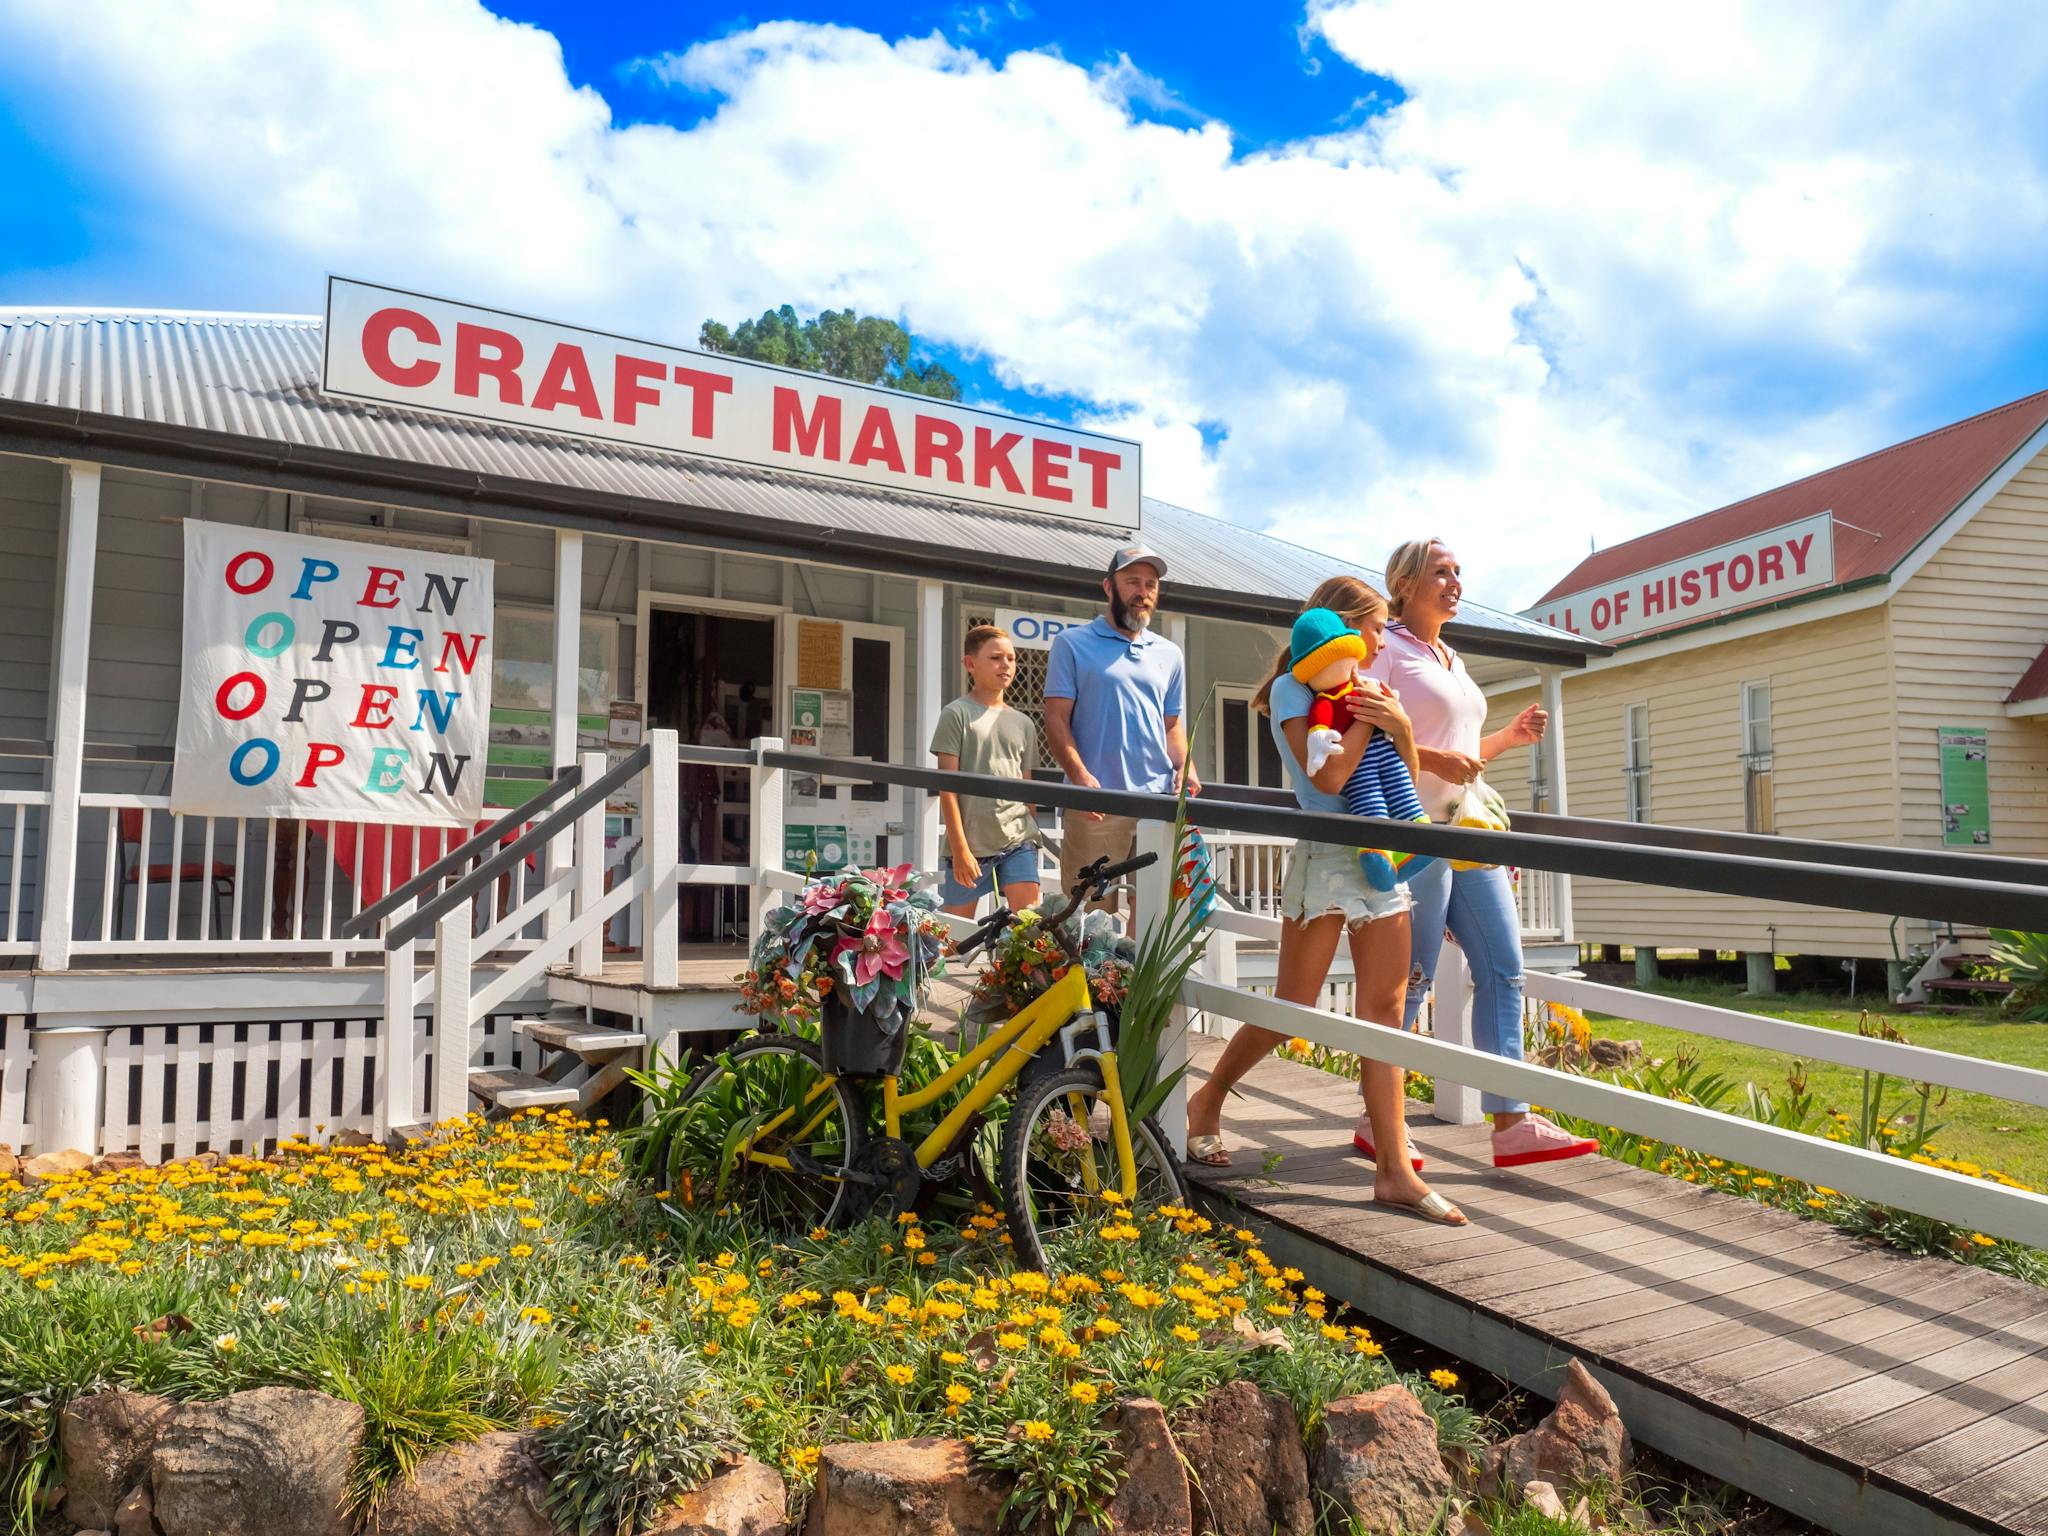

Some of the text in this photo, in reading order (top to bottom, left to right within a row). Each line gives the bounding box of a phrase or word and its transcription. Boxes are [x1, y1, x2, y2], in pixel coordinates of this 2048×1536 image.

[361, 307, 1122, 510] CRAFT MARKET
[225, 551, 469, 616] OPEN
[1591, 591, 1630, 631] OF
[1643, 533, 1814, 617] HISTORY
[244, 612, 487, 676] OPEN
[1012, 617, 1081, 642] OP
[215, 671, 462, 735] OPEN
[229, 737, 471, 797] OPEN
